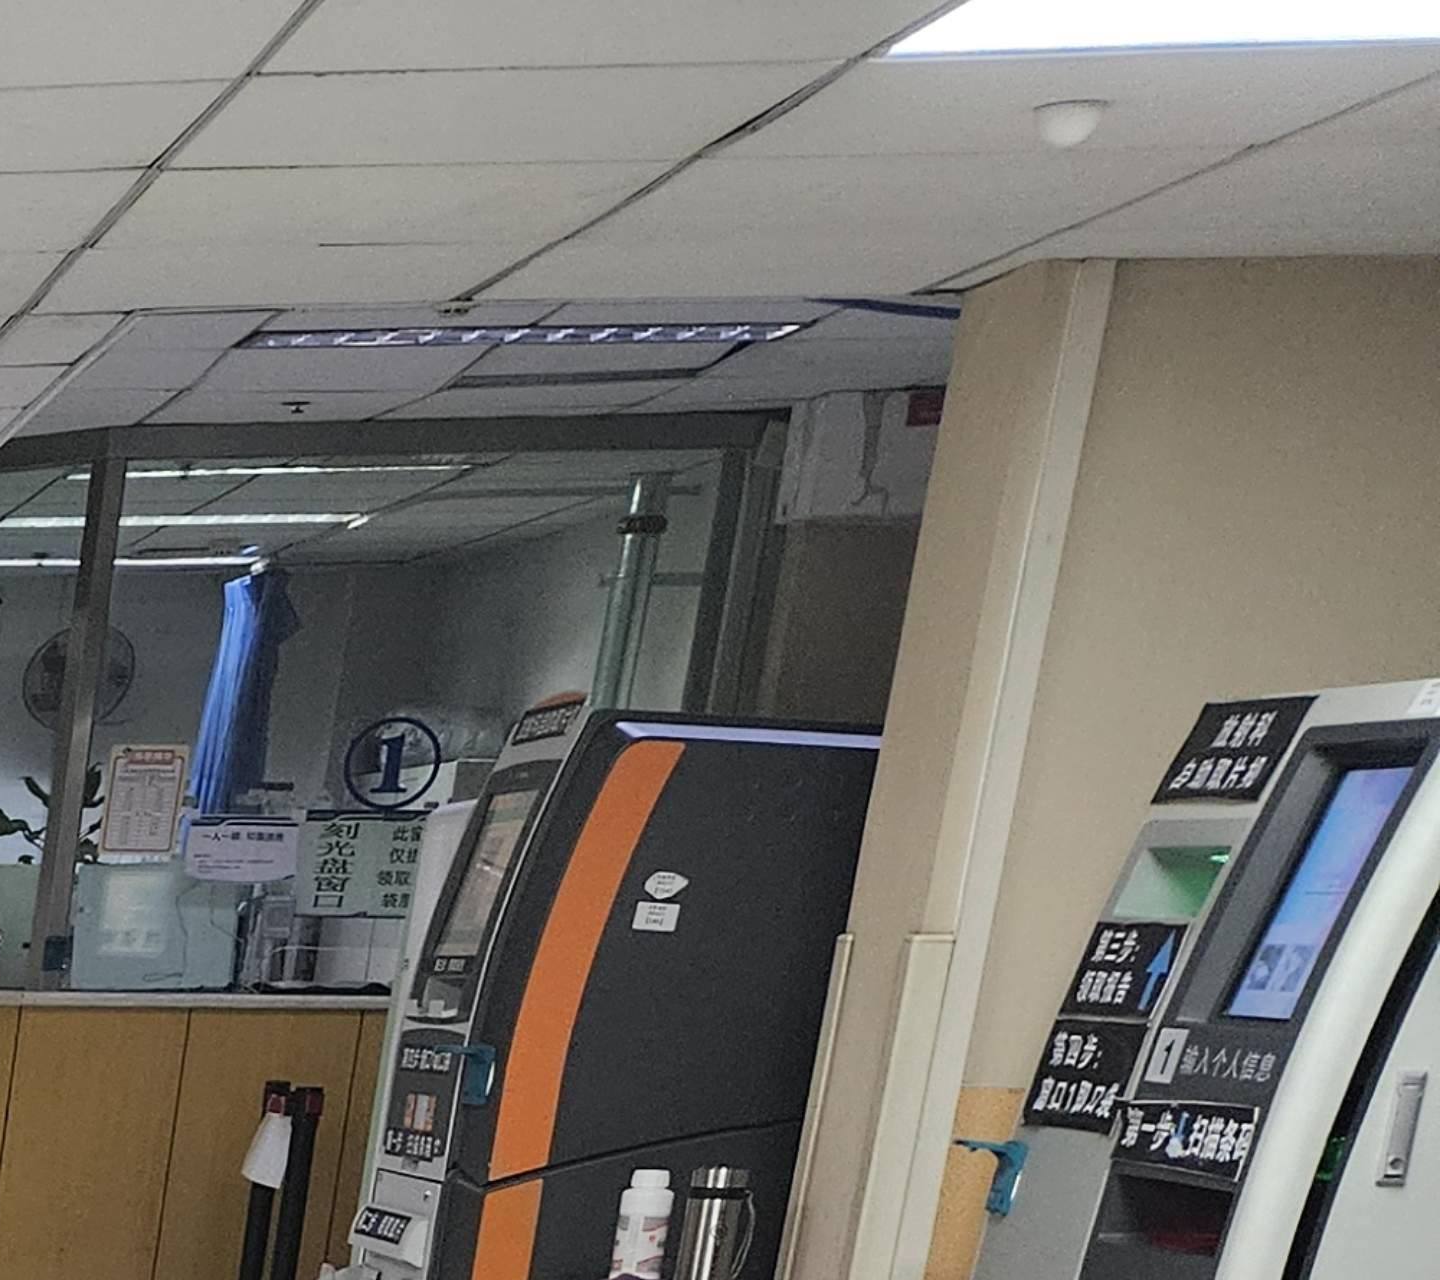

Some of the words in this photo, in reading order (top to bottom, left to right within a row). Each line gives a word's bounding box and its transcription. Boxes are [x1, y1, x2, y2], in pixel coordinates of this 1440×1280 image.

[1180, 1043, 1277, 1083] 输入个人信息
[1184, 1113, 1255, 1164] 扫描条码
